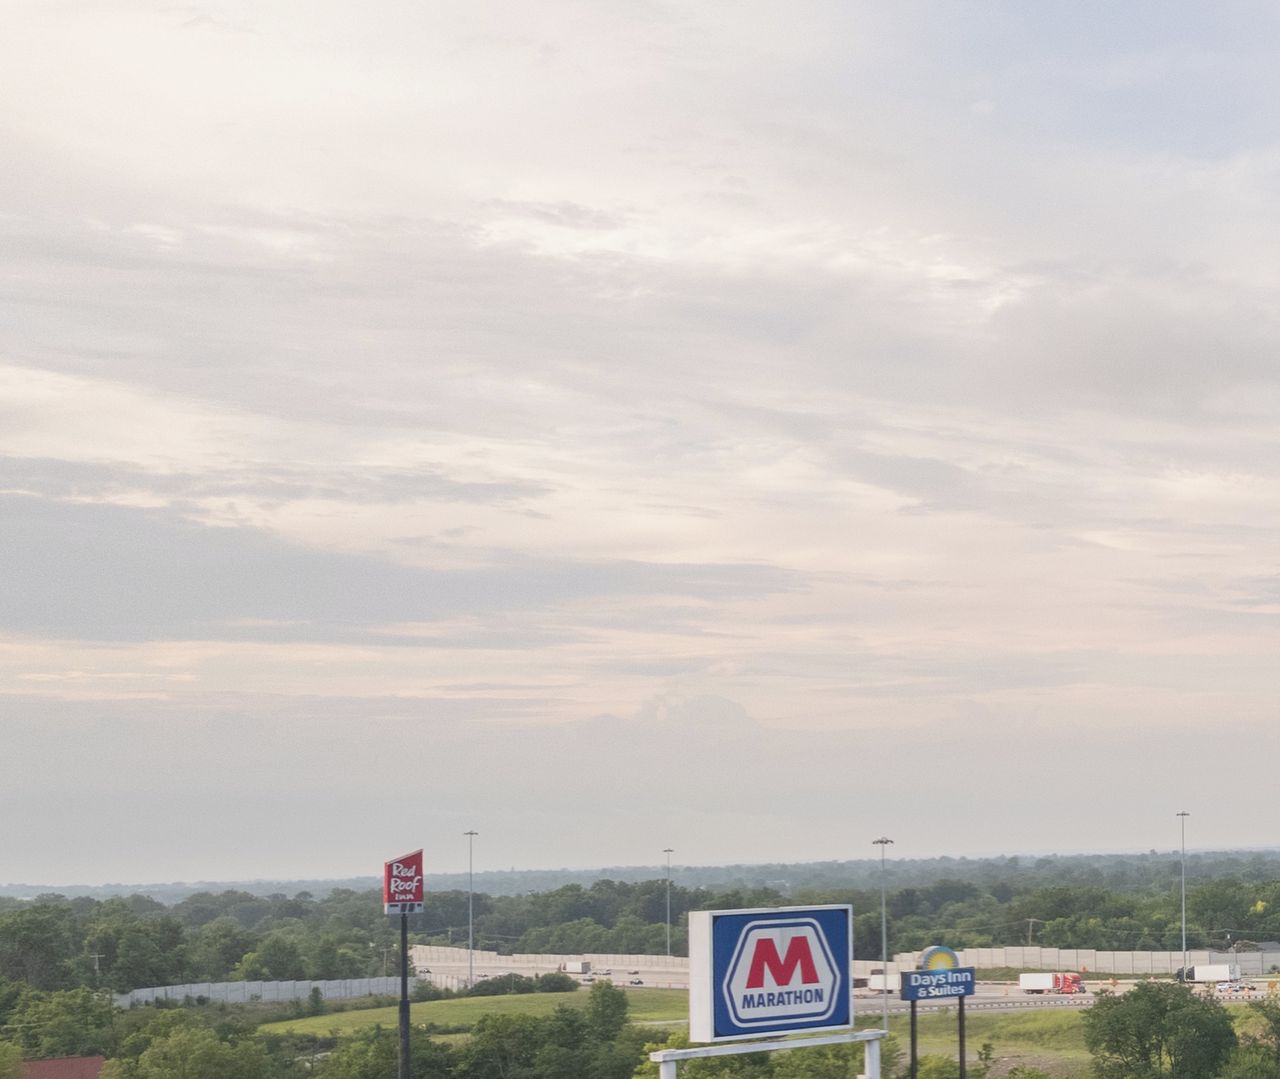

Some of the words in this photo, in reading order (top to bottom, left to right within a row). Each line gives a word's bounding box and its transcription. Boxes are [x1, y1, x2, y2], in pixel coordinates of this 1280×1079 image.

[392, 863, 416, 877] Red
[390, 876, 422, 893] Roof
[746, 936, 820, 989] M
[911, 974, 946, 986] Days
[948, 971, 972, 983] Inn
[742, 988, 824, 1009] MARATHON
[918, 987, 927, 997] &
[928, 985, 965, 997] Suites
